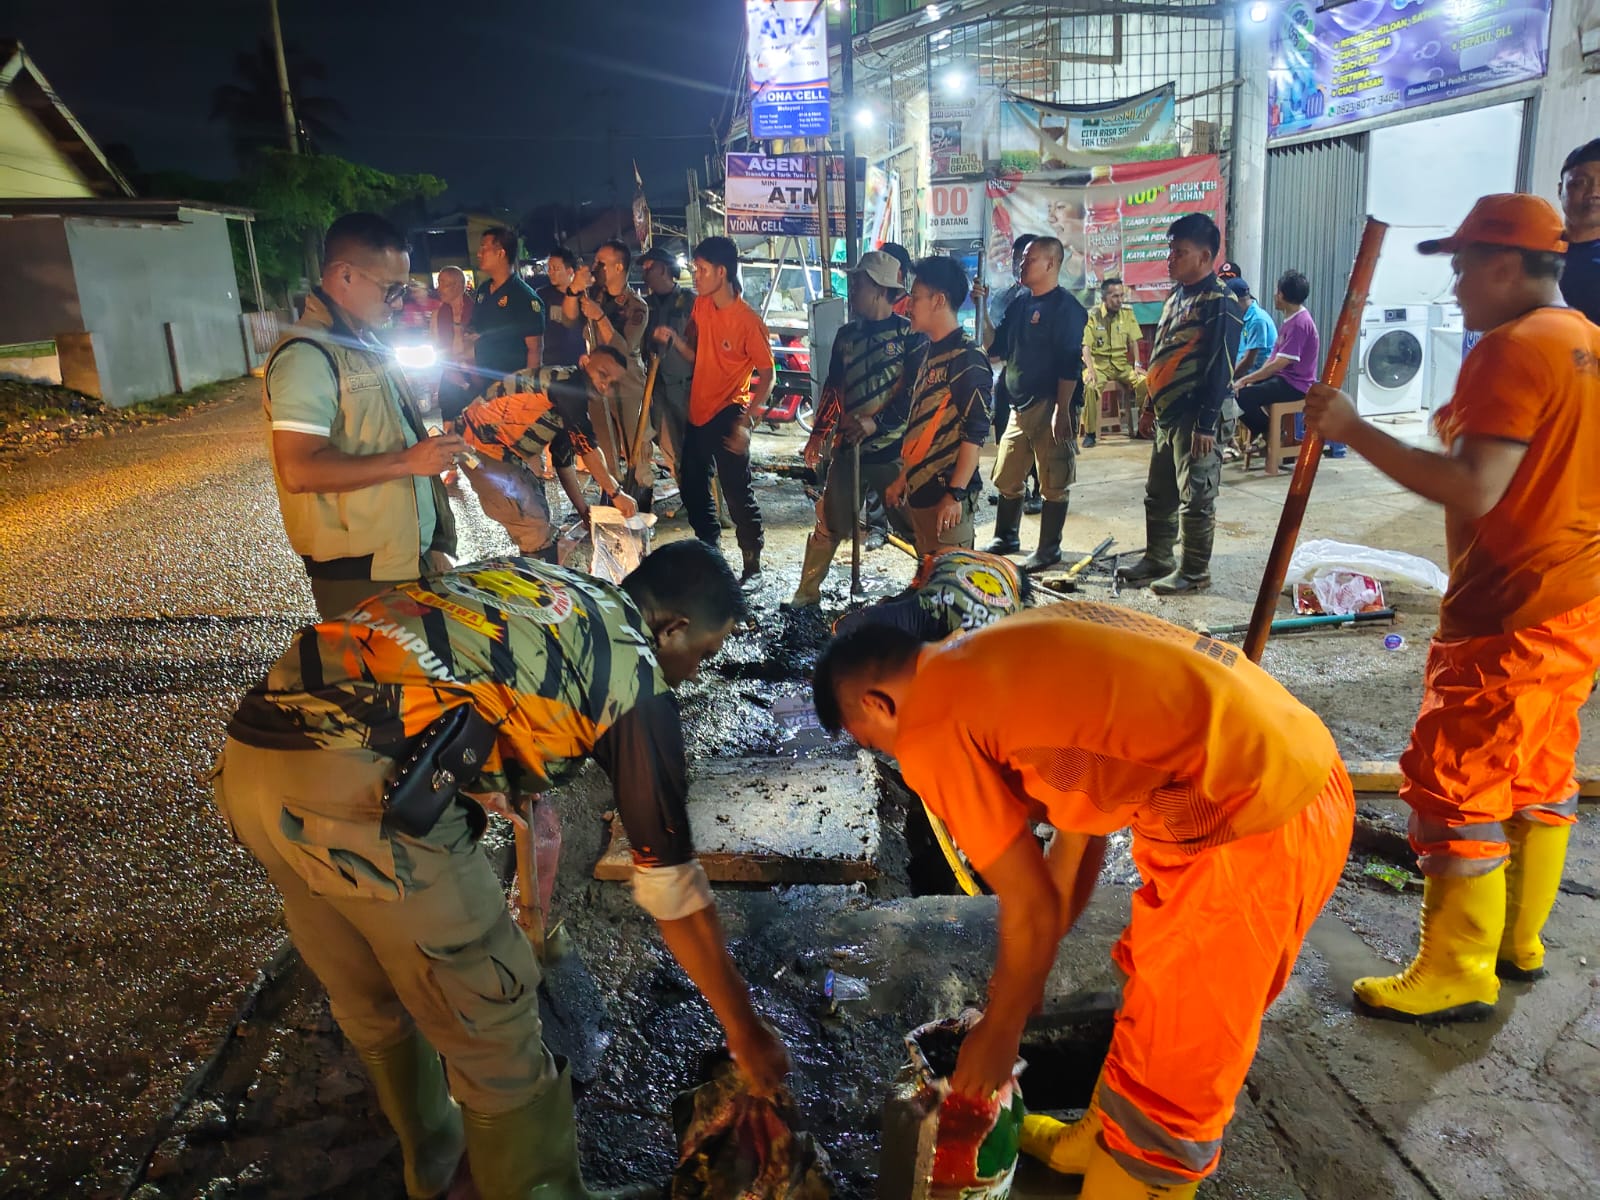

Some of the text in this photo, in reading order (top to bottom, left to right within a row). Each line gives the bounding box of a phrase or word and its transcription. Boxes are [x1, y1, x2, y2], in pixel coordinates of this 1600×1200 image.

[795, 89, 826, 100] CELL
[1081, 129, 1098, 138] CITA
[1099, 127, 1117, 137] RASA
[747, 157, 804, 172] AGEN
[1169, 182, 1200, 193] PUCUK
[1200, 180, 1217, 191] TEH
[768, 187, 819, 205] ATM
[1170, 190, 1205, 202] PILIHAN
[729, 219, 759, 232] VIONA
[761, 220, 785, 232] CELL
[941, 217, 969, 226] BATANG
[1126, 251, 1146, 260] KAYA
[363, 617, 466, 688] LAMPUN
